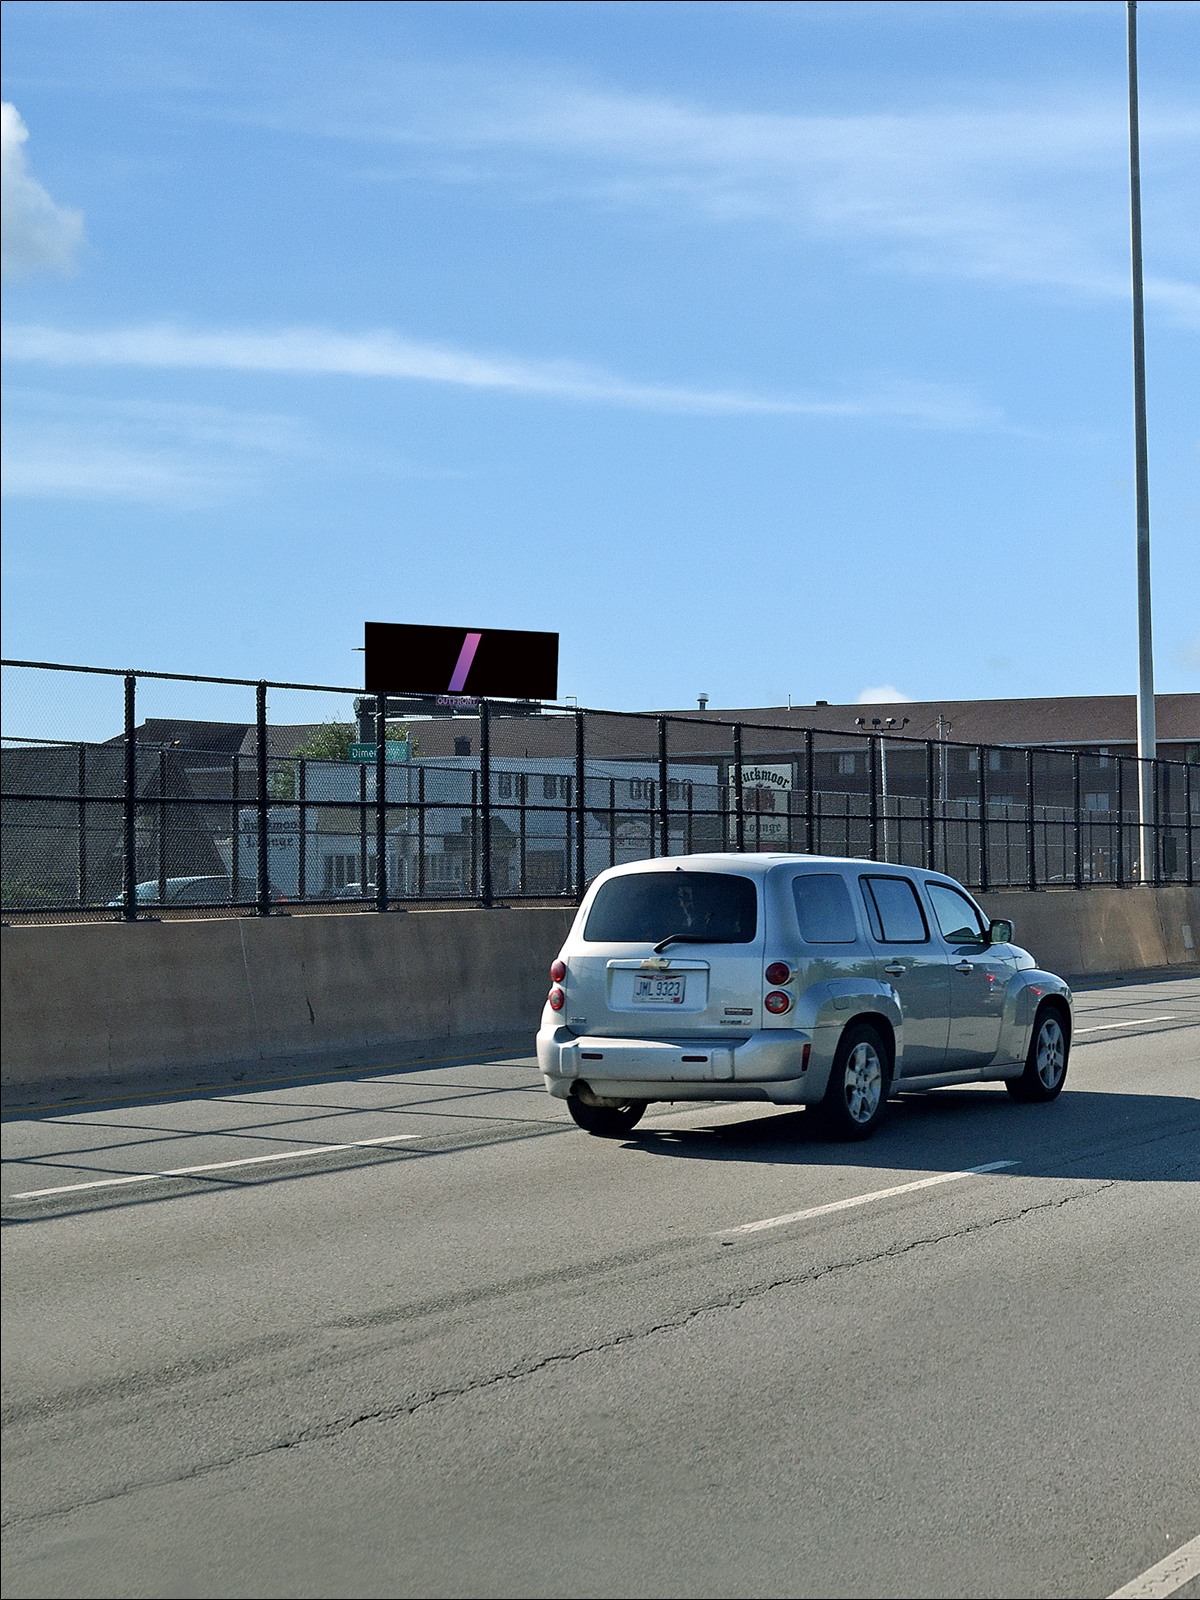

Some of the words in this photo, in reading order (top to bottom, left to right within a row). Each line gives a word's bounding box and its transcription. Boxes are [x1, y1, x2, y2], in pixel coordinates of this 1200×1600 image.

[437, 697, 477, 705] OUTFRONT
[636, 981, 653, 996] JML
[656, 981, 681, 996] 9323
